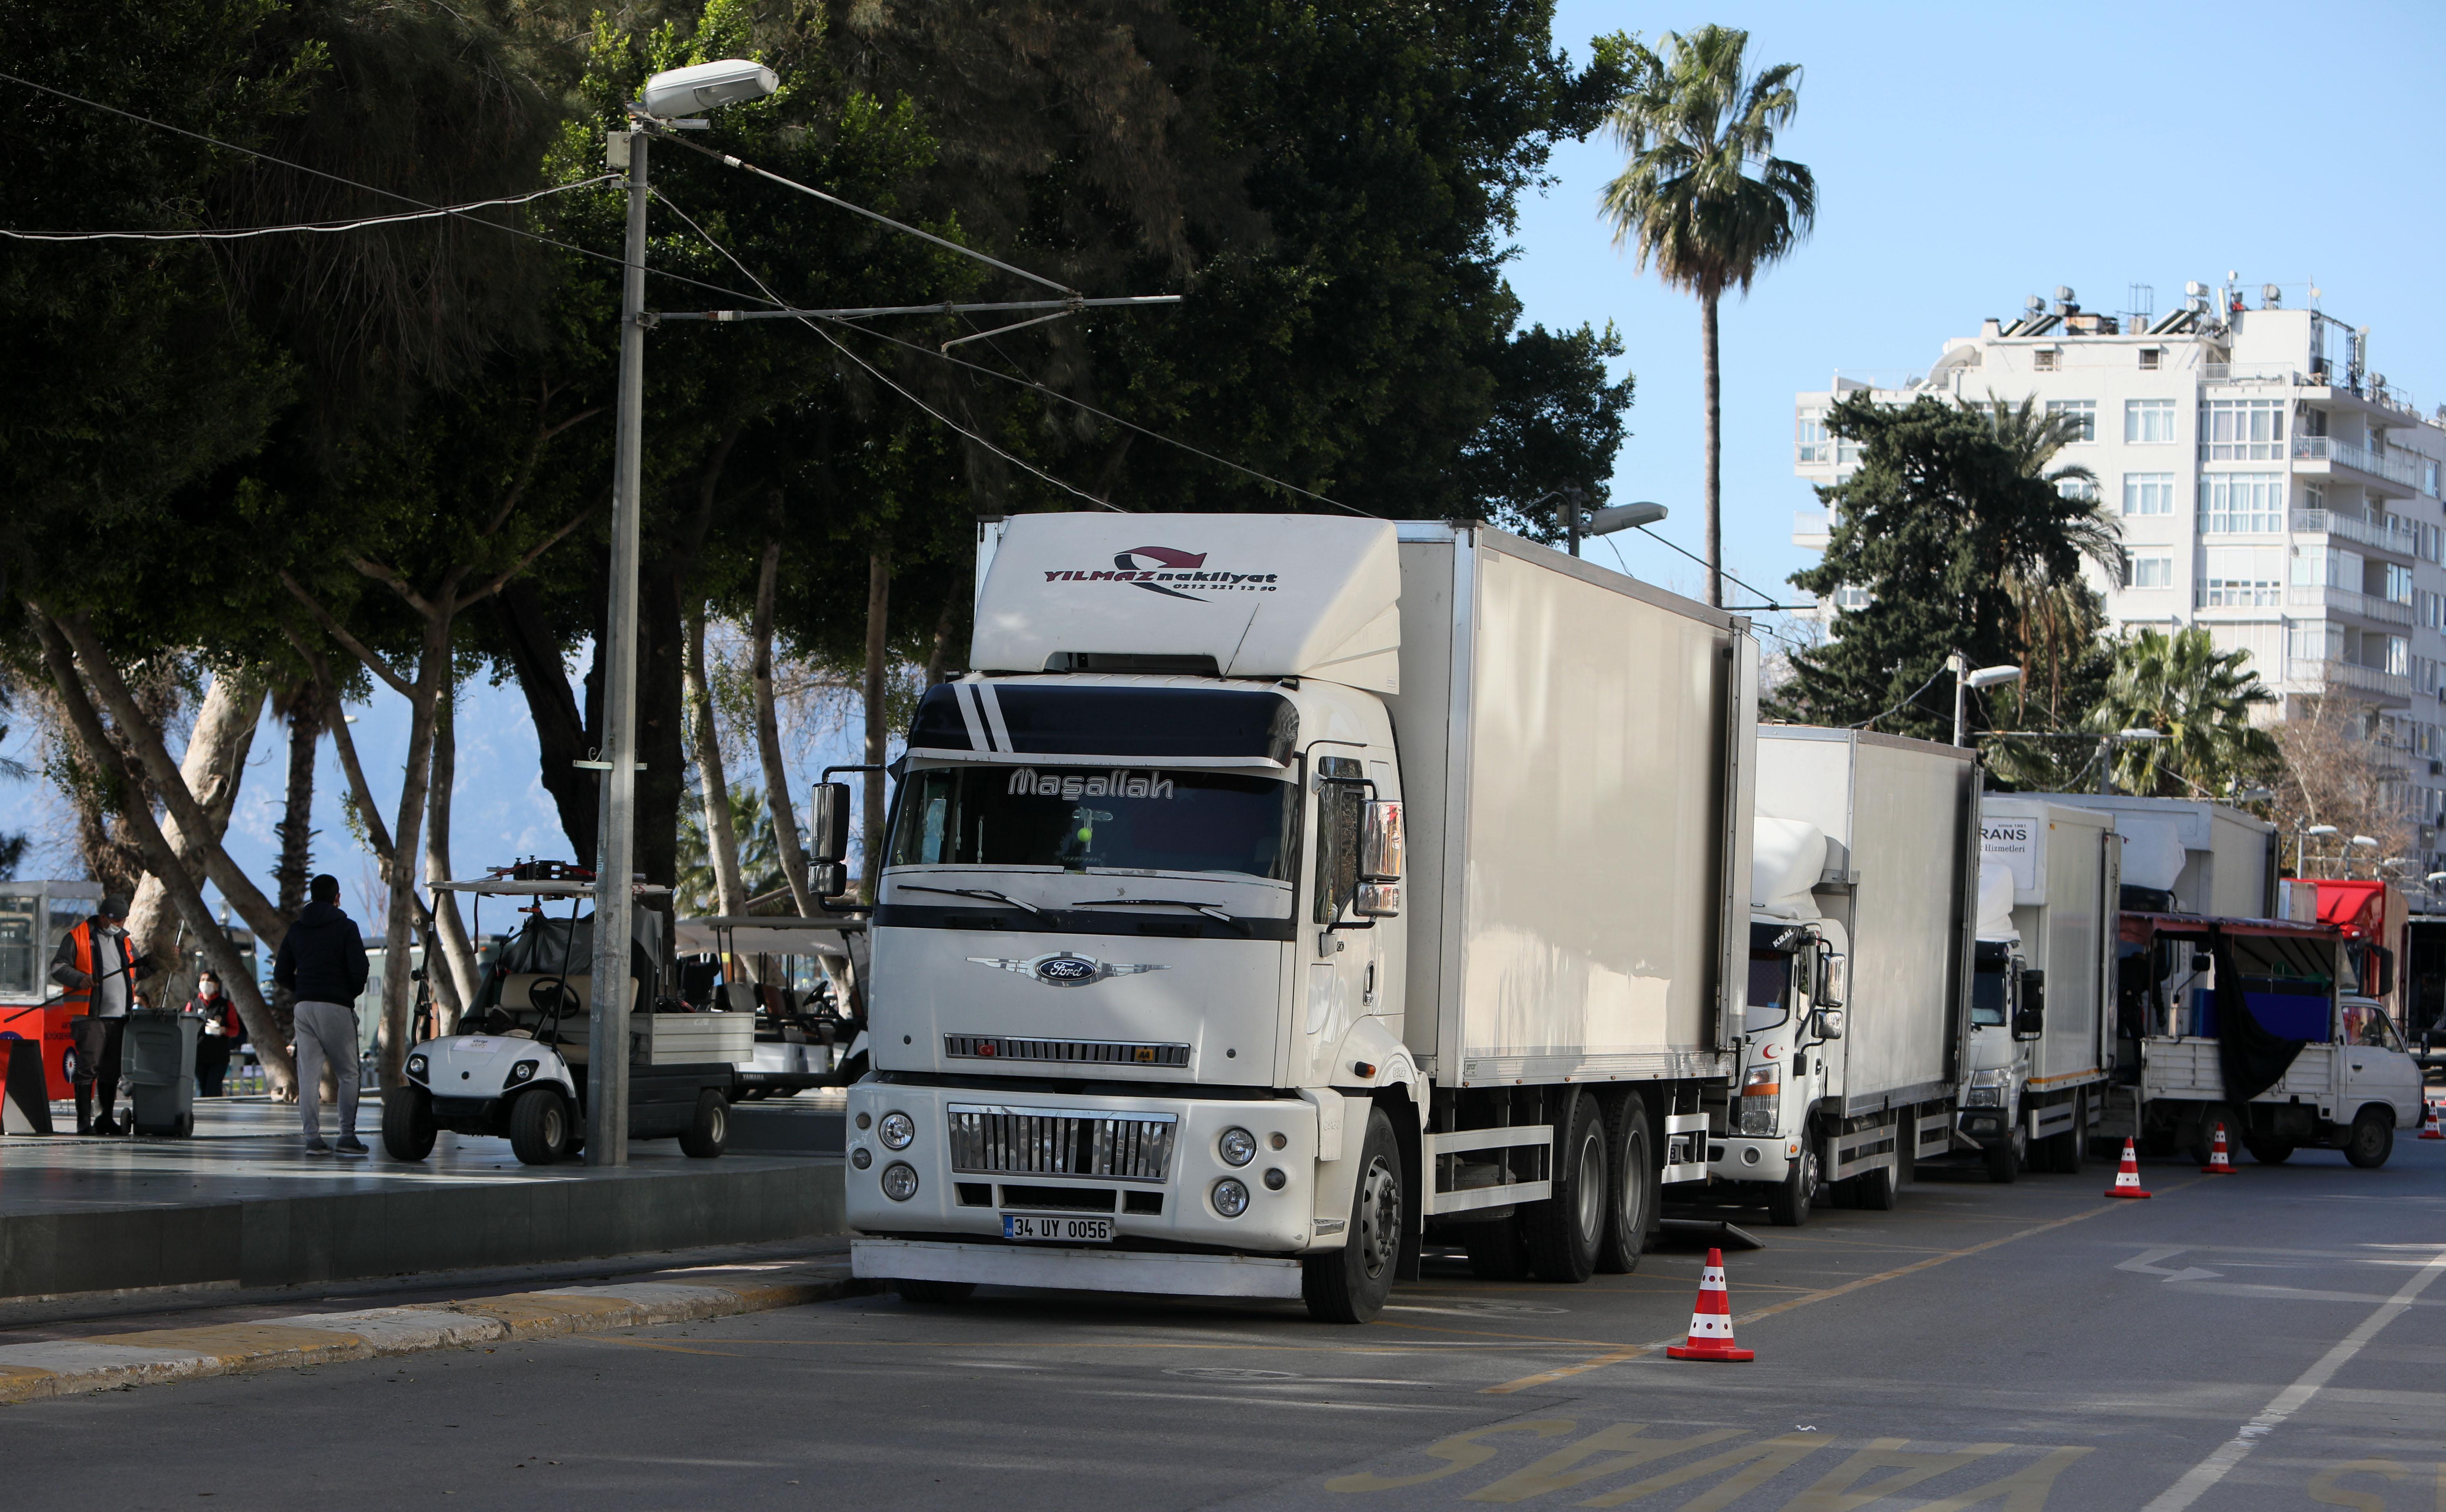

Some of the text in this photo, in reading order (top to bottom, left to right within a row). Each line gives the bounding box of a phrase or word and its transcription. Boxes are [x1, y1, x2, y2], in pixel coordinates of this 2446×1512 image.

[1985, 844, 2025, 852] Hizmetleri
[1772, 929, 1794, 948] KRAL
[1050, 962, 1083, 976] Ford
[1015, 1218, 1033, 1237] 34
[1042, 1220, 1060, 1237] UY
[1068, 1221, 1107, 1239] 0056
